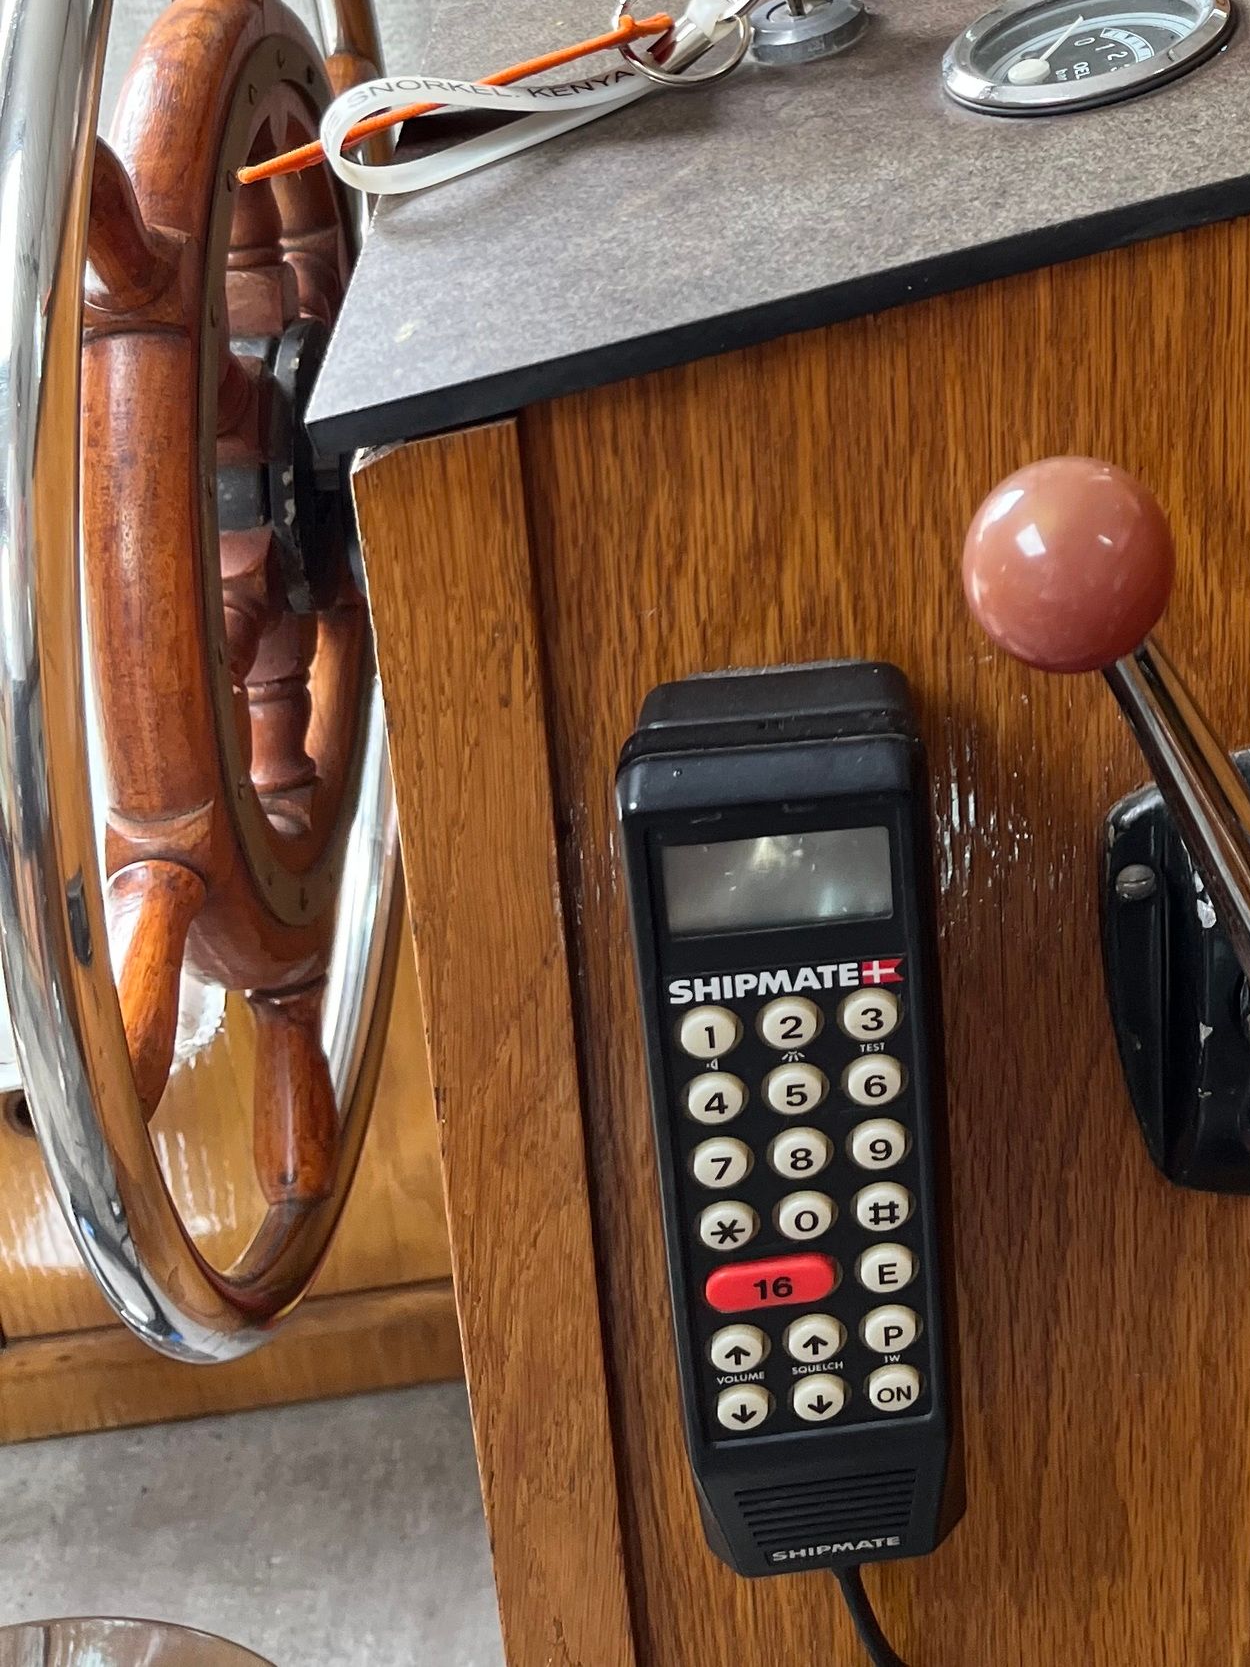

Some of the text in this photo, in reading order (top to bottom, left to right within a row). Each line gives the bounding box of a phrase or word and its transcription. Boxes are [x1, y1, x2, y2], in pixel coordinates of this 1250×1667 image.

[1074, 37, 1128, 61] 0 1 2
[528, 68, 635, 98] KENYA
[1073, 61, 1091, 80] OEL
[669, 962, 860, 1004] SHIPMATE
[704, 1008, 884, 1049] 1 2 3
[860, 1042, 886, 1053] TEST
[704, 1074, 888, 1115] 4 5 6
[710, 1138, 893, 1181] 7 8 9
[753, 1263, 899, 1301] 16 E
[884, 1325, 904, 1347] P
[717, 1361, 844, 1384] VOLUME SQUELCH
[877, 1385, 912, 1404] ON
[772, 1536, 902, 1563] SHIPMATE
